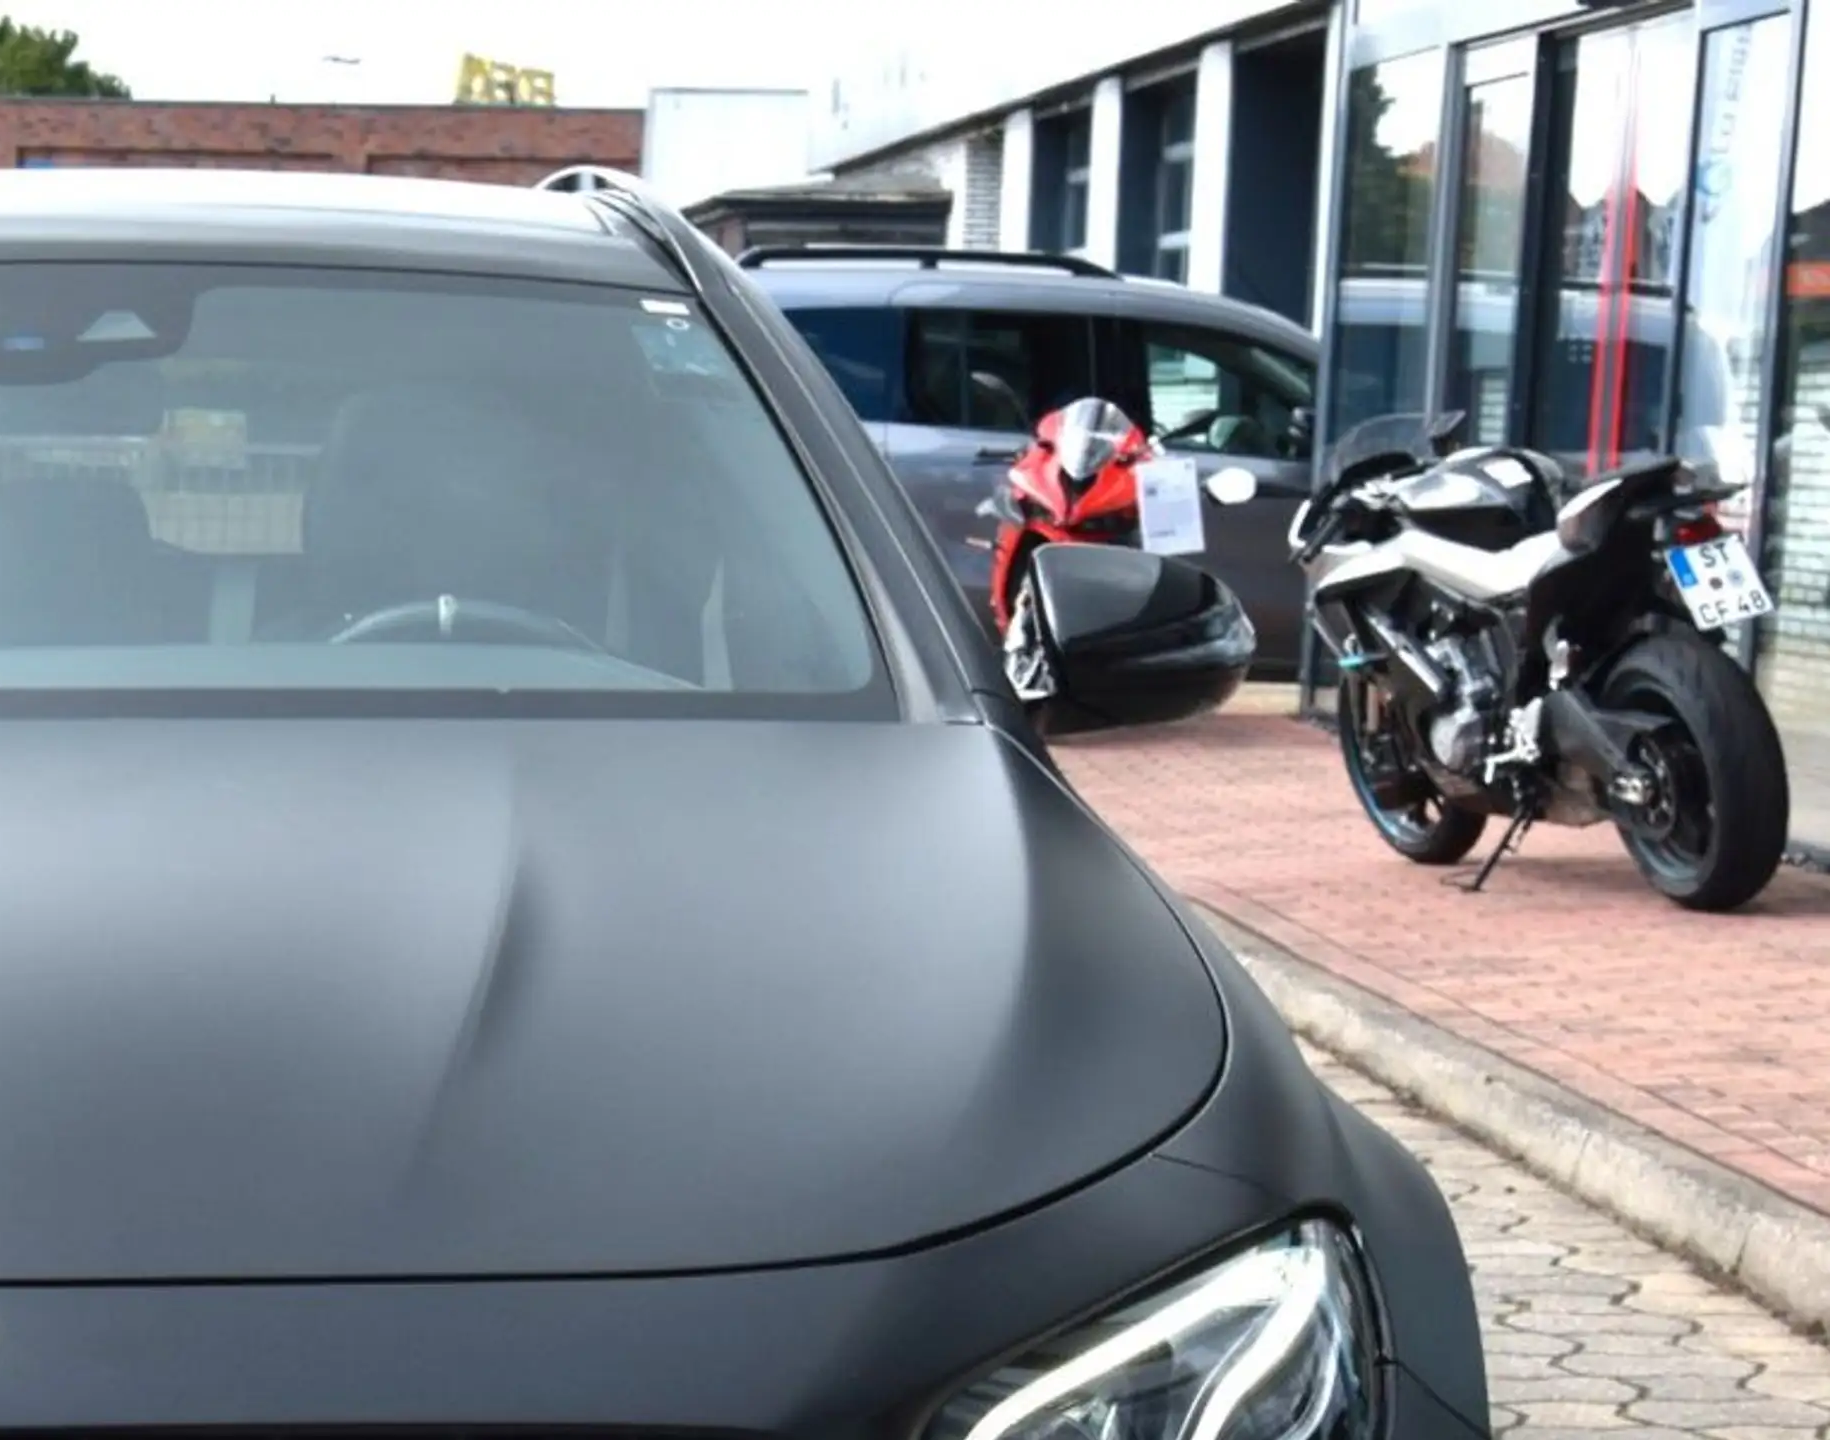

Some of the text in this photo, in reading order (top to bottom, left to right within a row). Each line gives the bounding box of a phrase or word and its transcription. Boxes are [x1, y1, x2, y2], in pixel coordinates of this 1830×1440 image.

[1697, 541, 1730, 569] ST
[1697, 589, 1767, 625] CF 48
